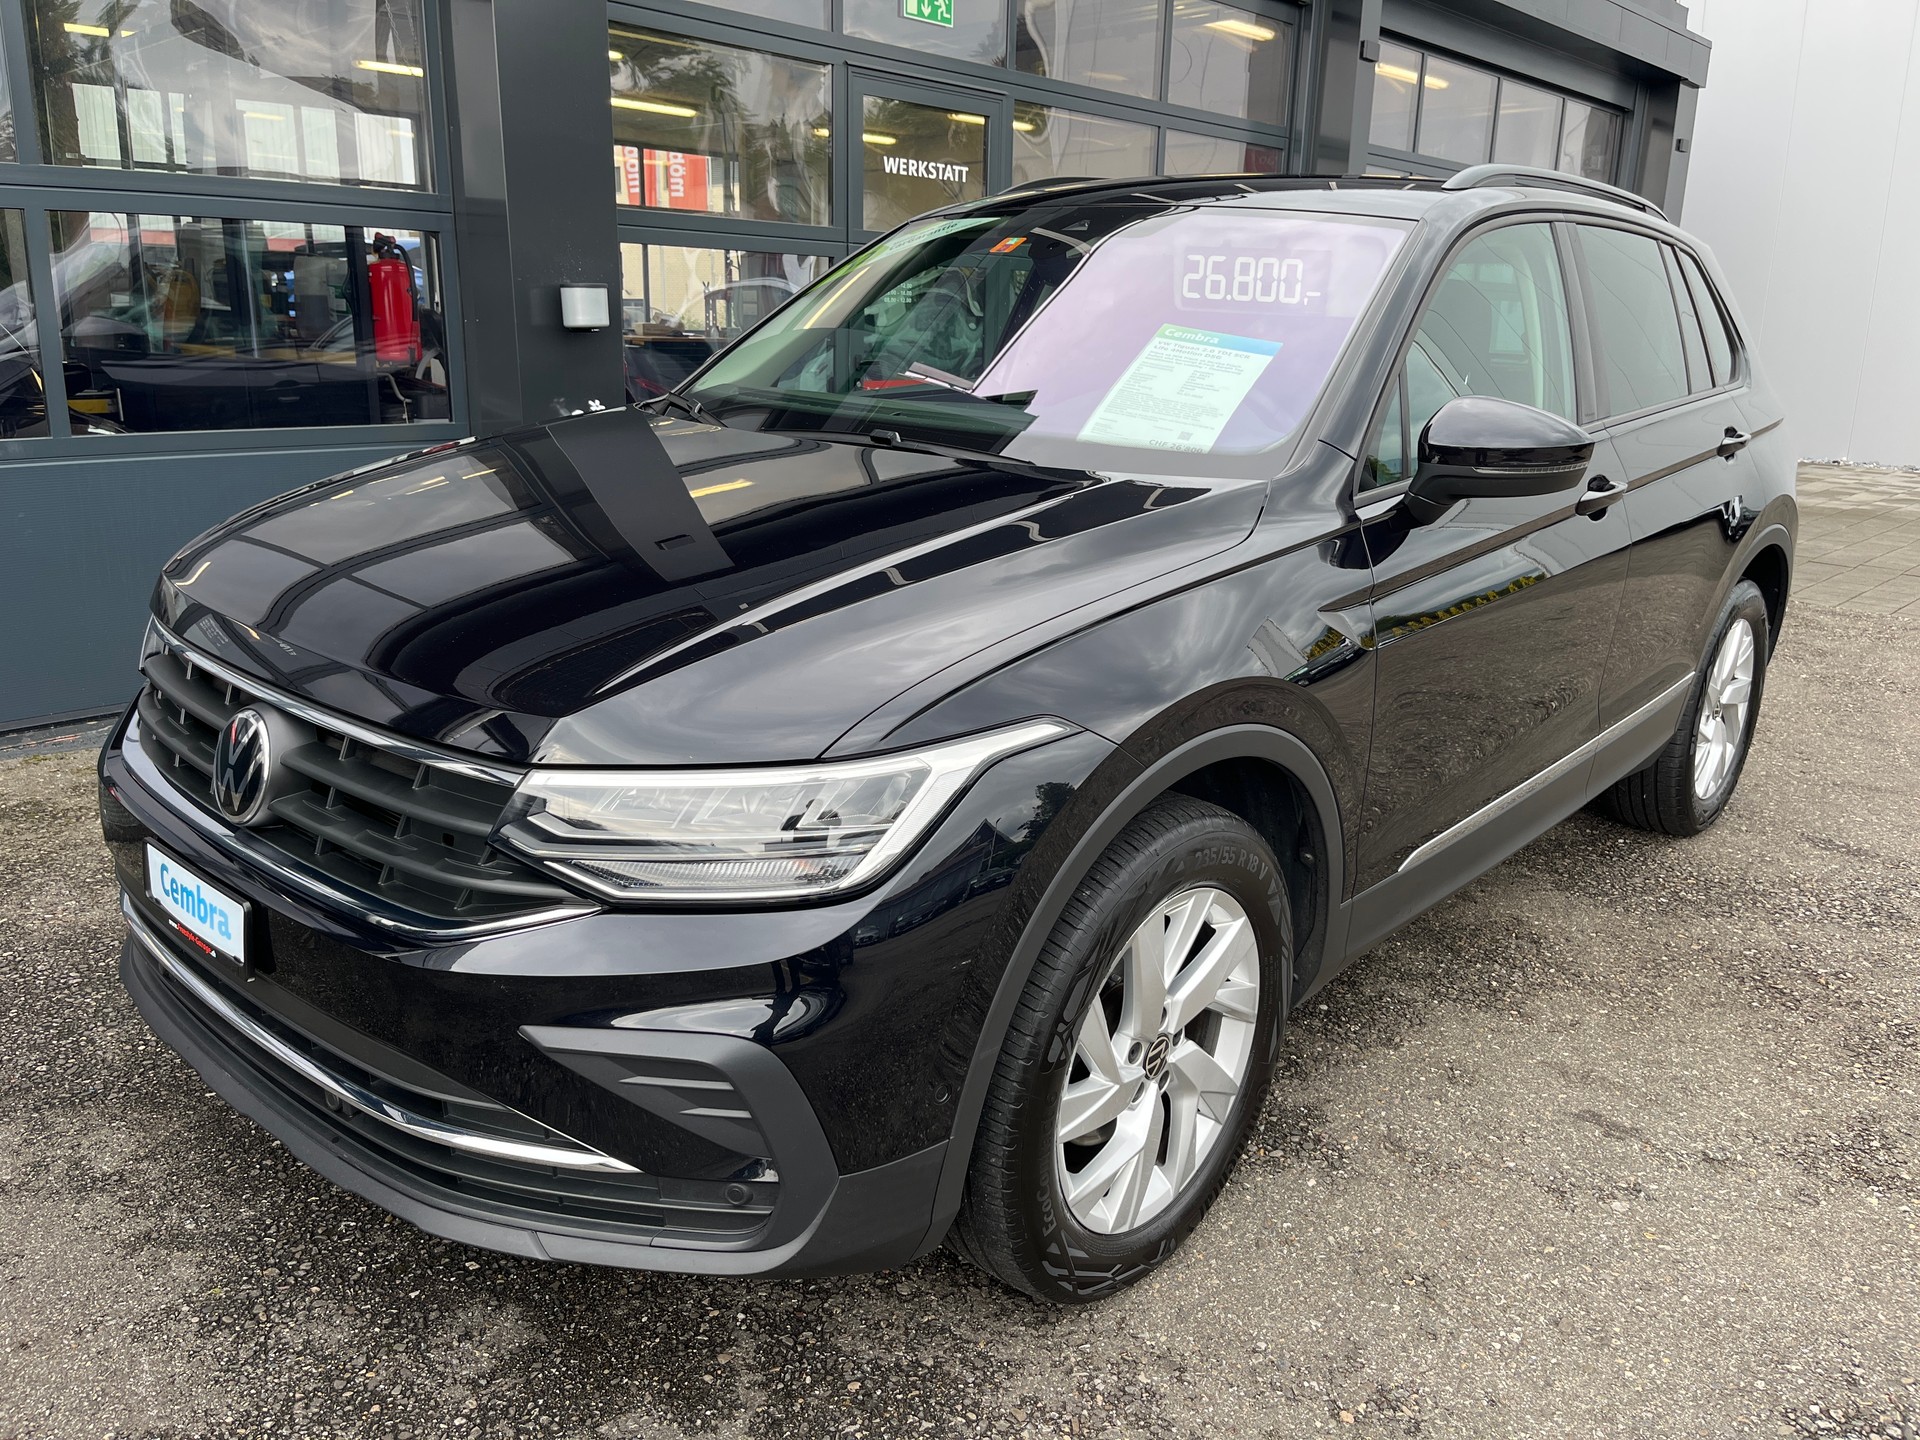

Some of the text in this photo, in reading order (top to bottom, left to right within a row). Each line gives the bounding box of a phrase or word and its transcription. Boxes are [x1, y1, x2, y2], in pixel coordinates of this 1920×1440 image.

[883, 155, 969, 183] WERKSTATT
[1165, 328, 1219, 344] Cembra
[1174, 342, 1200, 352] Tiguan
[1202, 346, 1216, 354] 2.0
[1217, 349, 1232, 357] TDI
[1149, 439, 1168, 448] CHF
[1195, 846, 1269, 880] 235/55 R 18 V
[160, 863, 231, 940] Cembra
